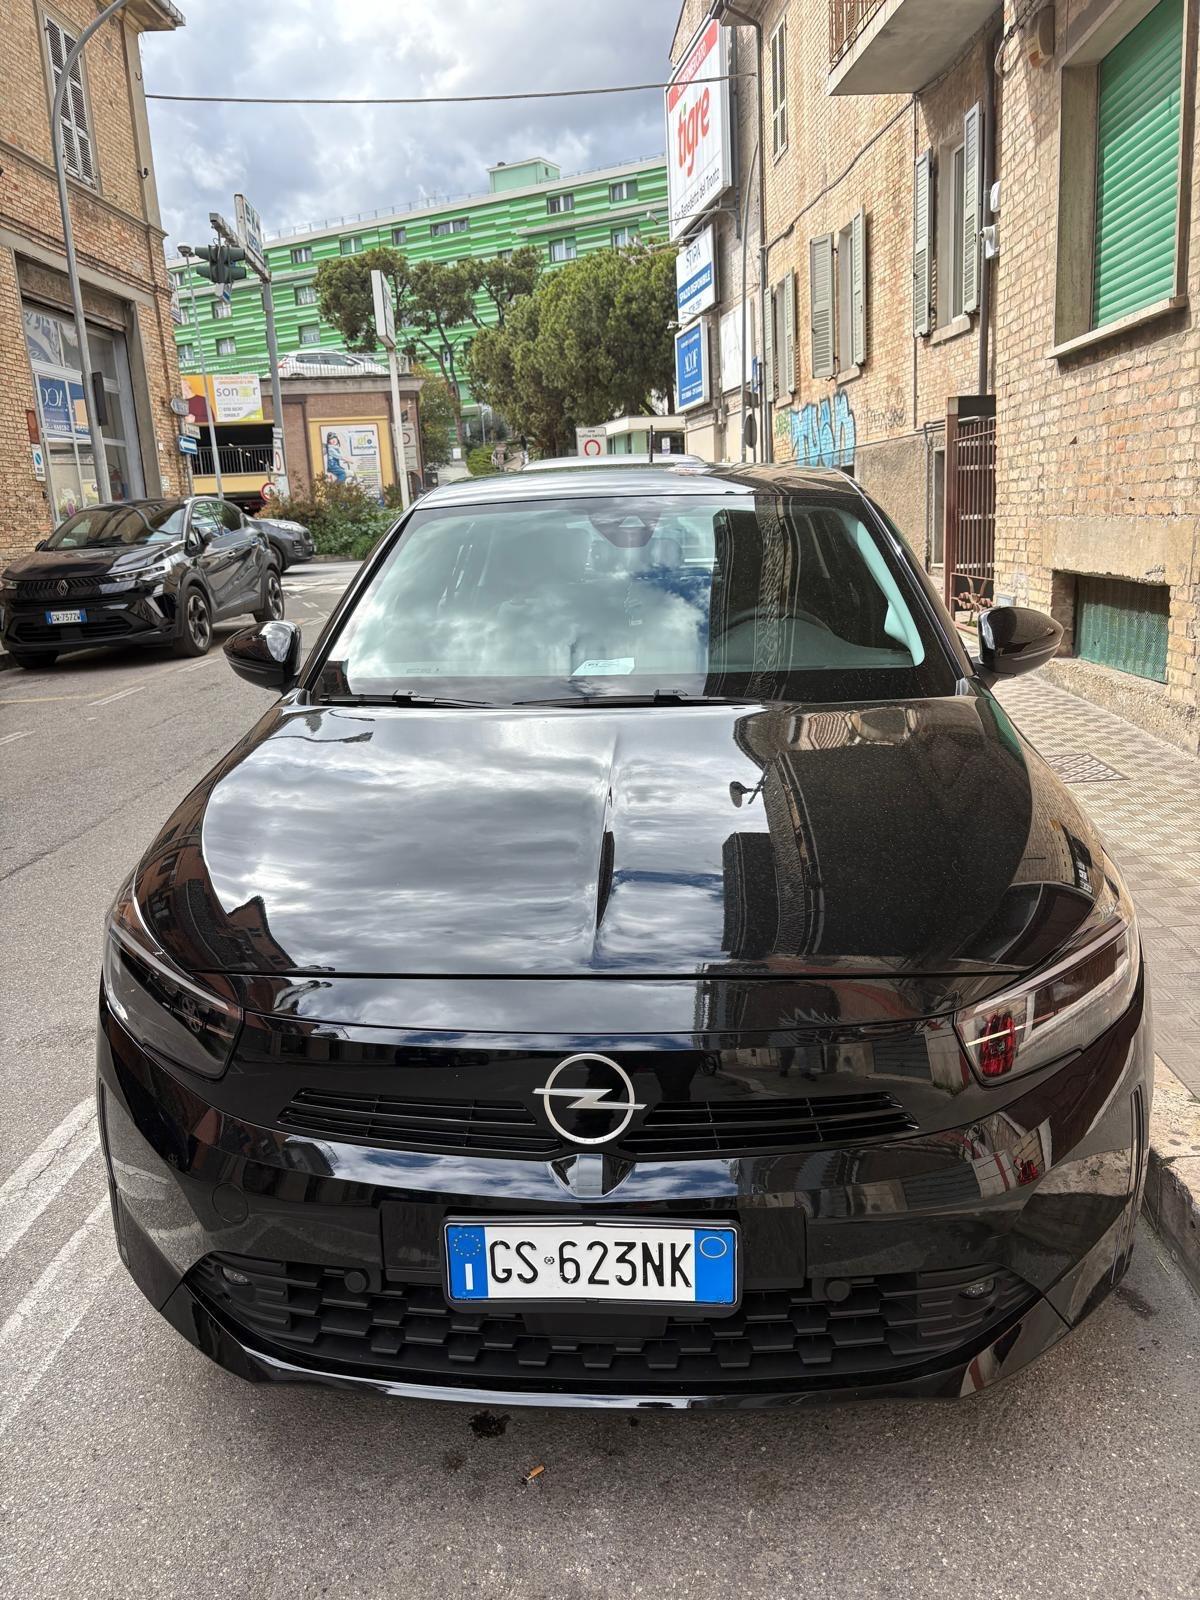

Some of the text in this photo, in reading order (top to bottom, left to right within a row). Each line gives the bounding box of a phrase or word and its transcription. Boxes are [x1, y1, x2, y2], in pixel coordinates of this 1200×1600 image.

[678, 87, 710, 177] tigre
[489, 1240, 693, 1288] GS 623NK
